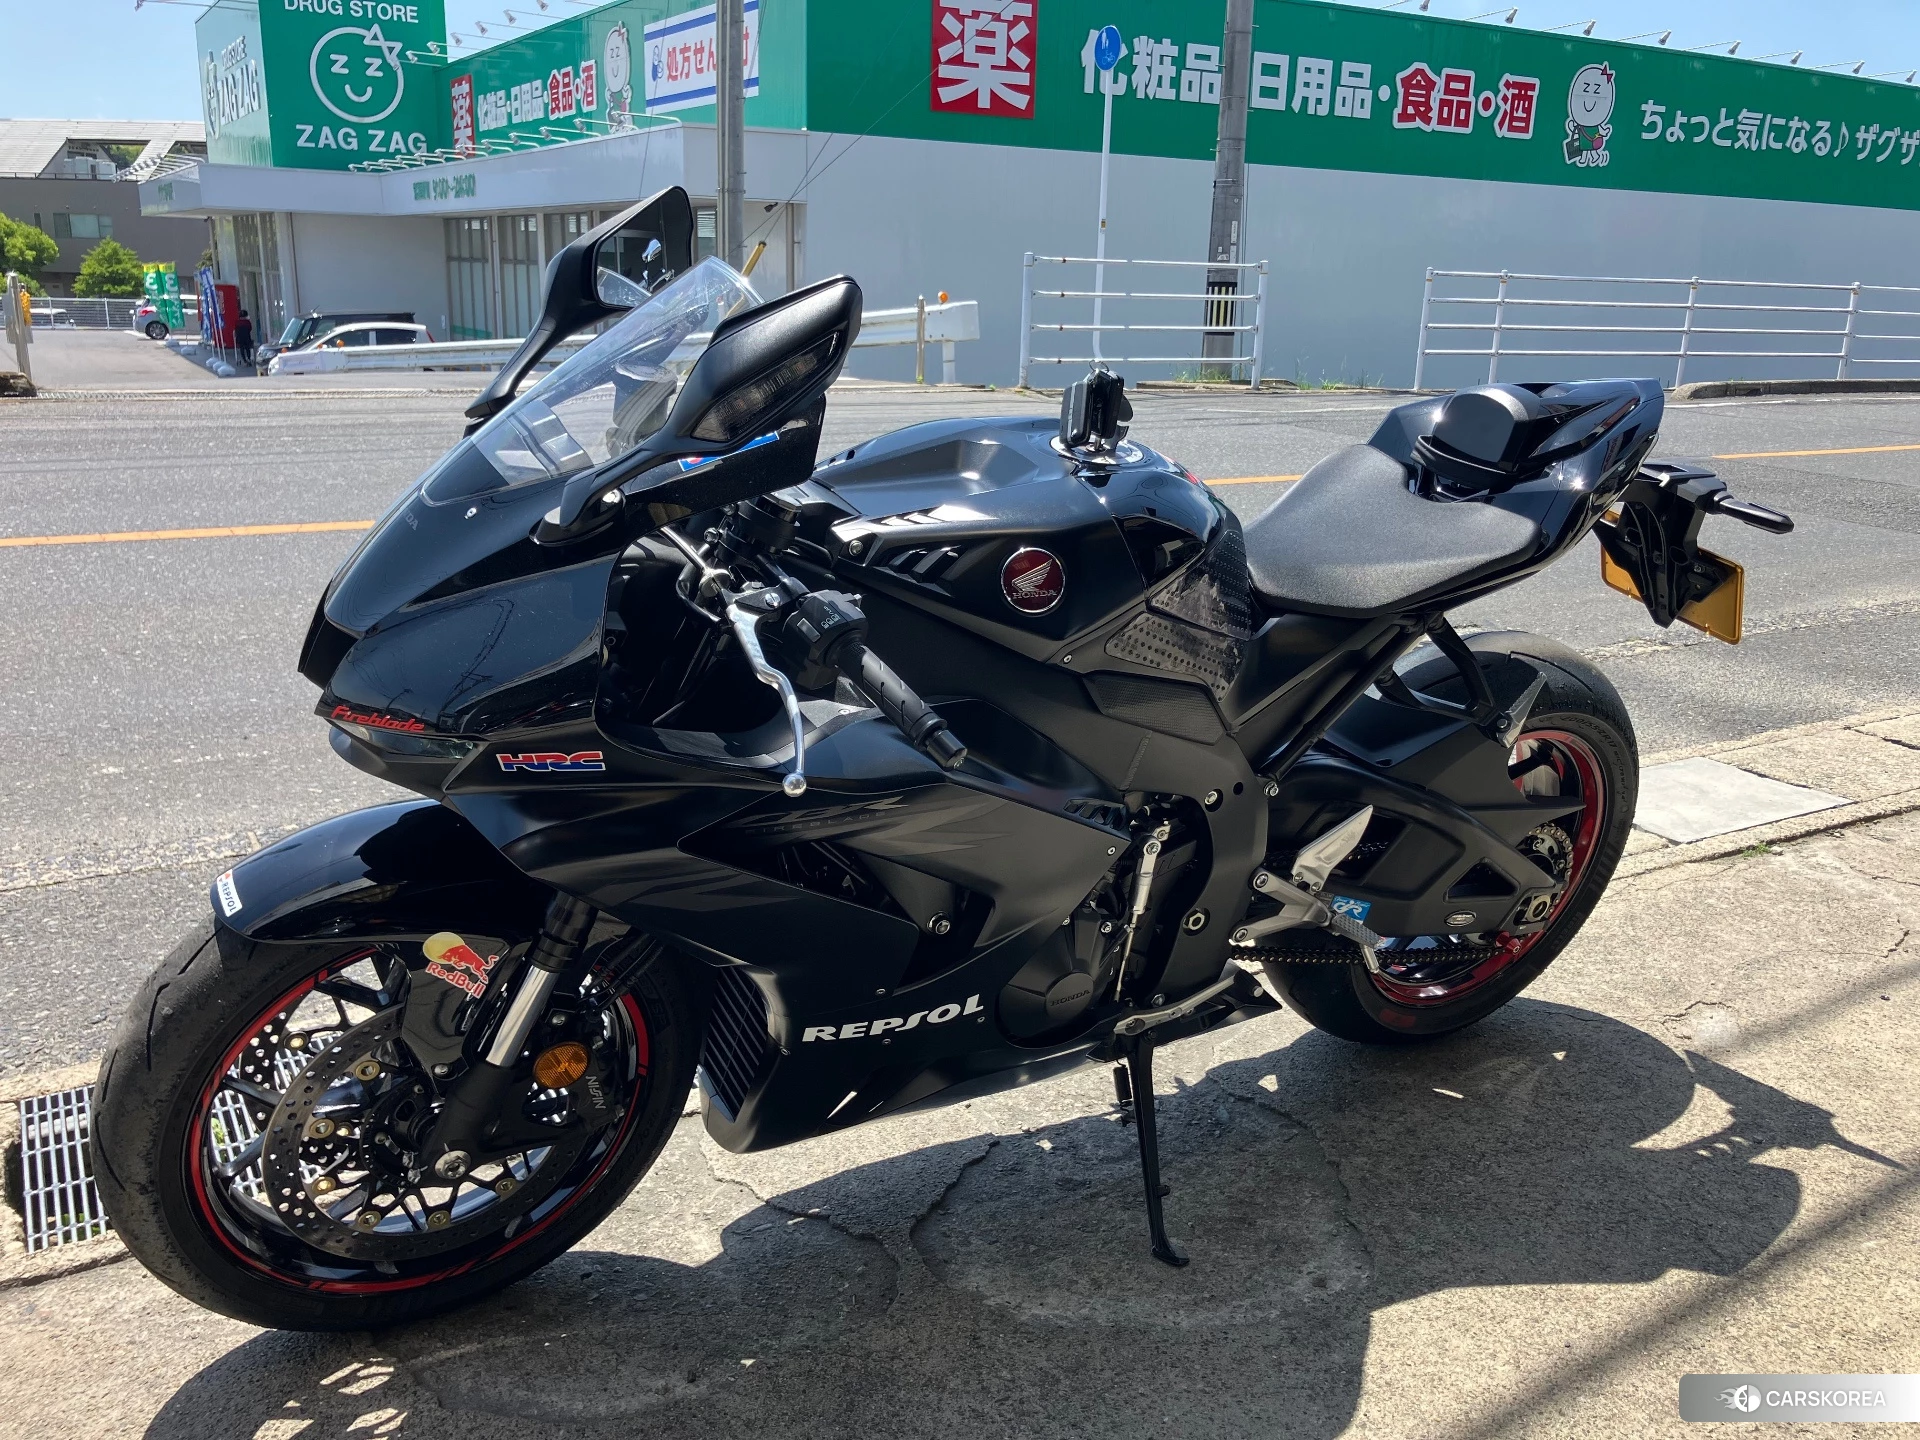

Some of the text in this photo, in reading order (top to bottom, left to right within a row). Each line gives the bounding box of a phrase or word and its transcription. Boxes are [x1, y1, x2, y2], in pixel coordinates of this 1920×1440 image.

[284, 0, 419, 23] DRUG STORE
[936, 0, 1031, 111] 薬
[296, 124, 428, 154] ZAG ZAG
[1012, 589, 1058, 599] HONDA
[331, 705, 425, 733] Fireblade
[496, 751, 606, 772] HRC
[222, 881, 237, 912] REPSOL
[1050, 989, 1091, 1007] HONDA
[802, 994, 984, 1042] REPSOL
